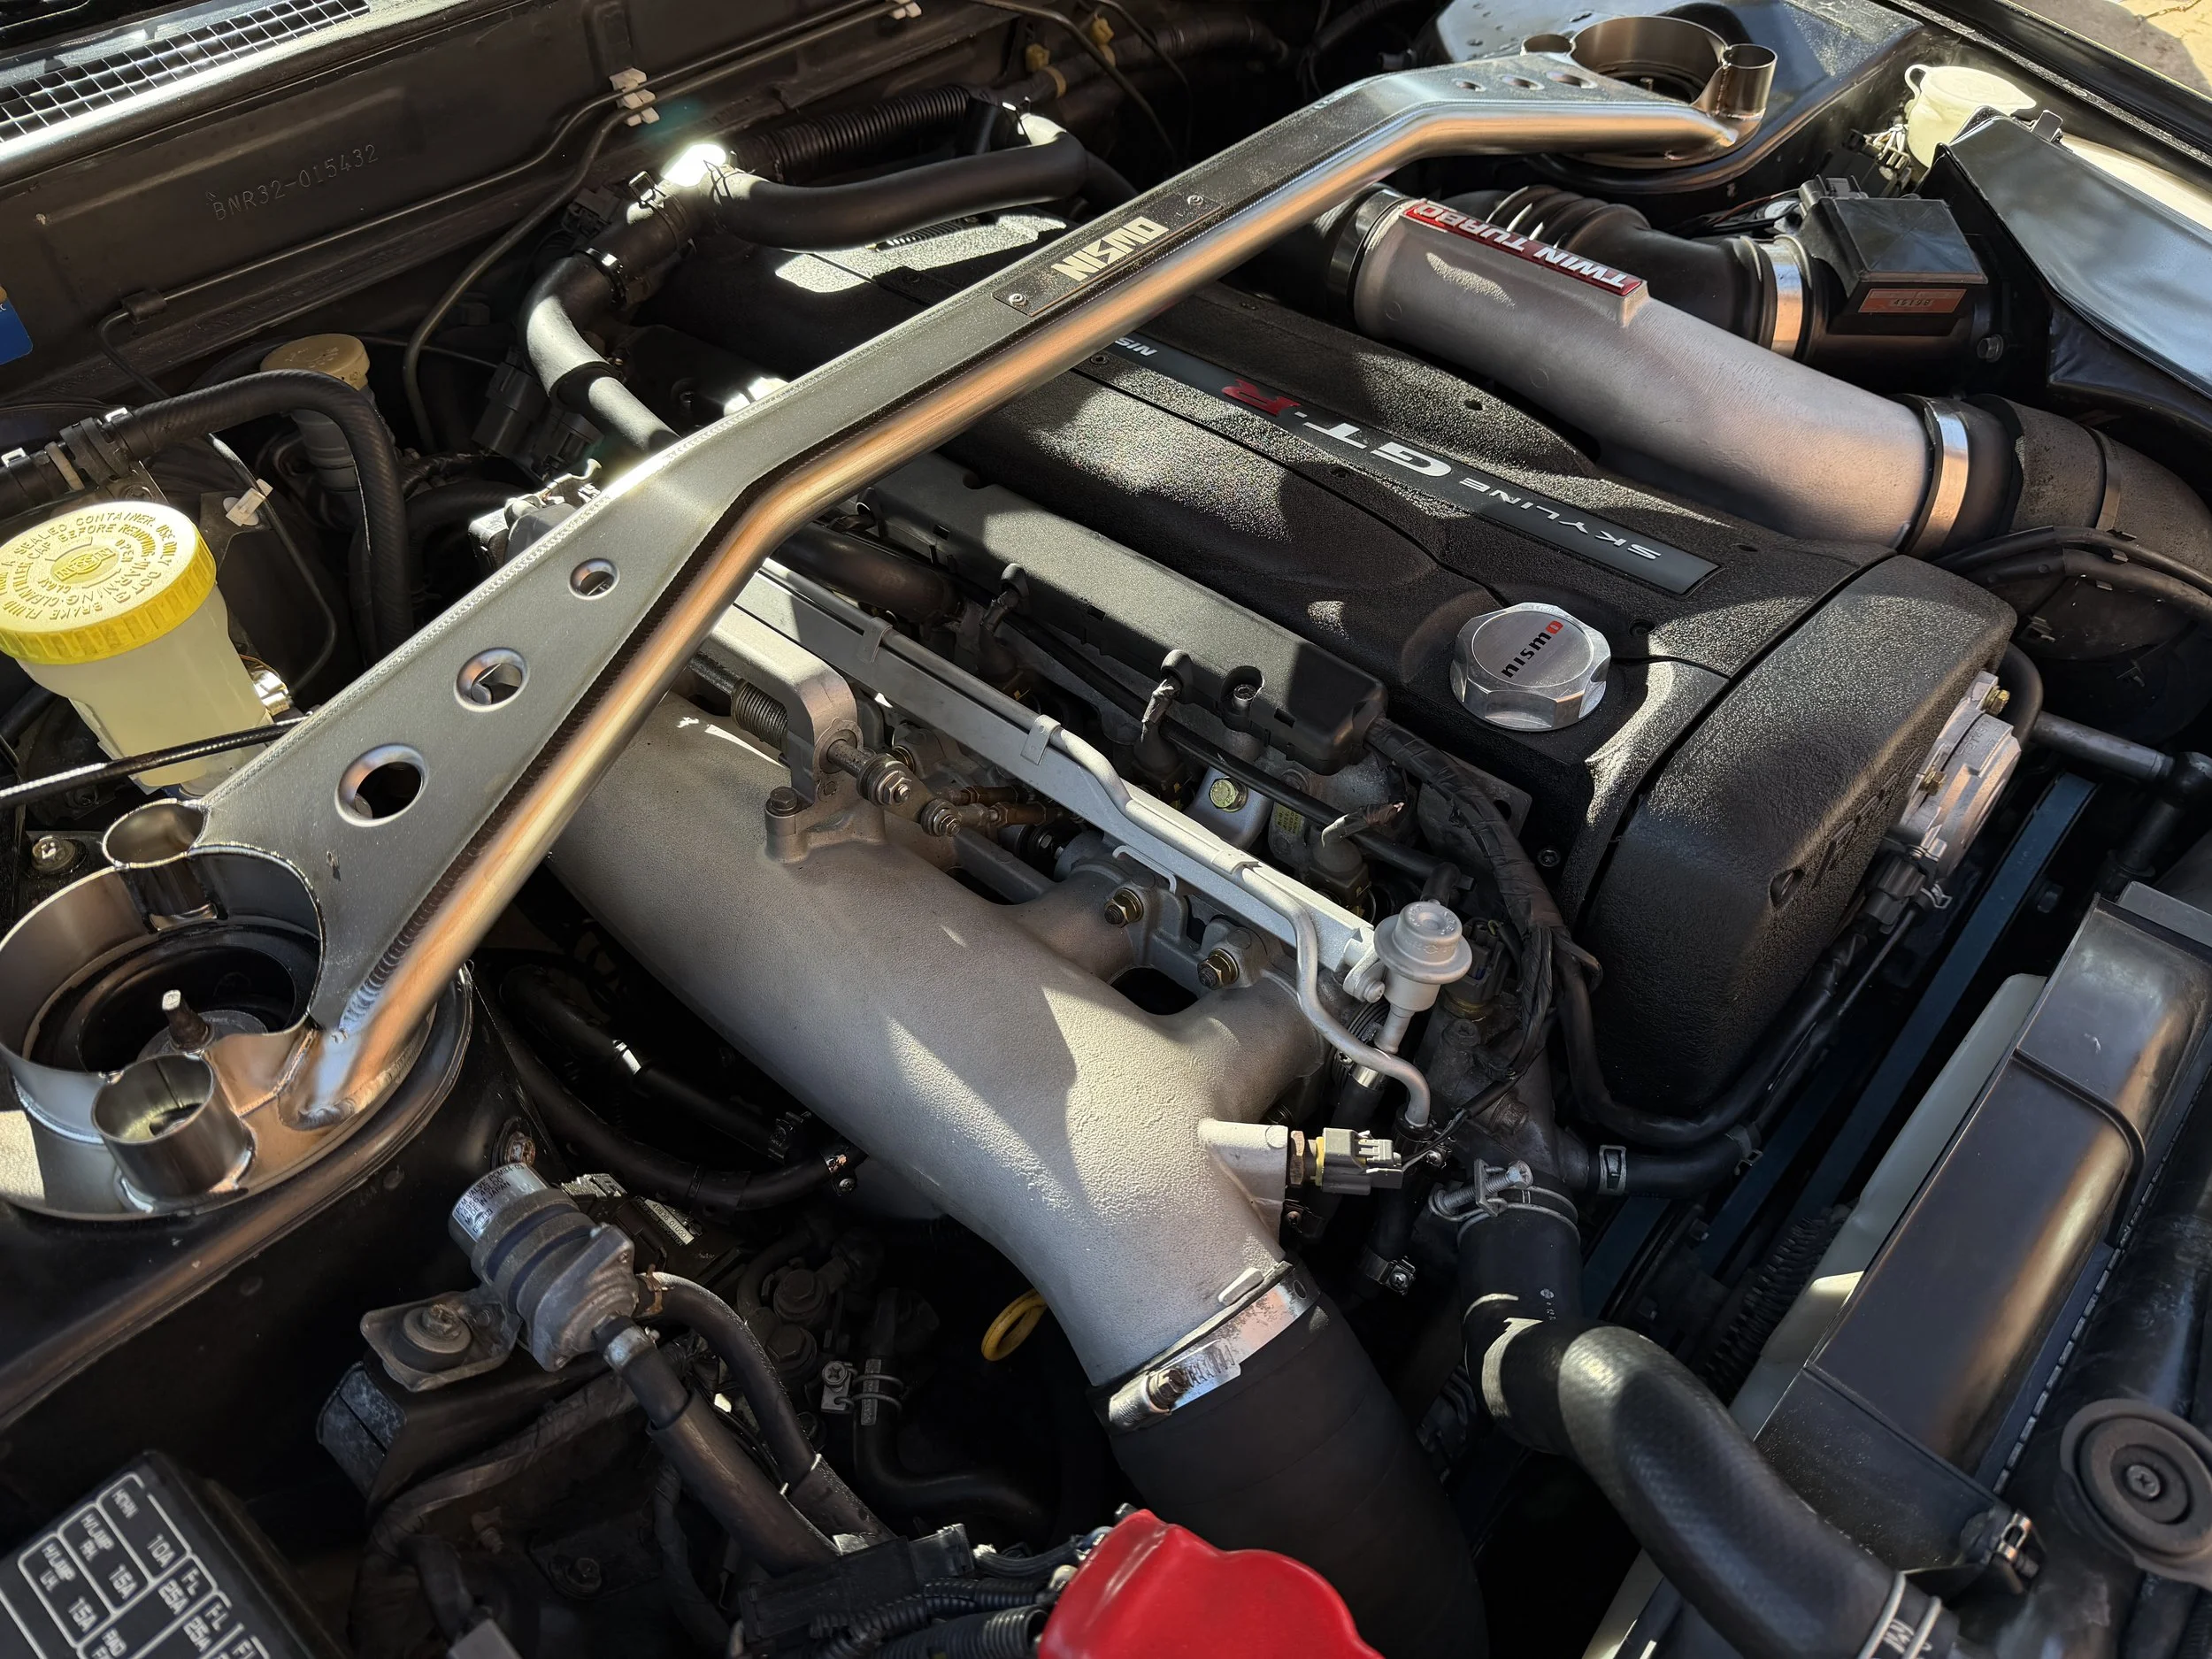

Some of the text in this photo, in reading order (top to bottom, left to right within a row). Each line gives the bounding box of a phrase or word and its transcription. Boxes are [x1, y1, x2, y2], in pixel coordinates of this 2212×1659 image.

[212, 143, 380, 221] BNR32-015432
[1050, 215, 1170, 282] NISMO
[1413, 204, 1628, 290] TWIN TURBO
[1221, 377, 1453, 478] GT-R
[58, 523, 117, 543] BEFORE
[1459, 477, 1663, 561] SKYLINE
[54, 548, 115, 581] NISSAN
[115, 538, 134, 564] OPEN
[130, 571, 162, 595] DOT
[49, 603, 104, 620] BRAKE
[1501, 620, 1564, 679] nismo
[455, 1198, 468, 1215] PCM
[467, 1179, 489, 1199] VALVE
[459, 1194, 480, 1218] 14956
[465, 1204, 480, 1225] MADE
[479, 1197, 488, 1207] IN
[488, 1181, 511, 1201] JAPAN
[81, 1513, 115, 1551] H/LAMP
[42, 1542, 76, 1581] H/LAMP
[147, 1533, 176, 1569] 10A
[108, 1563, 138, 1600] 15A
[157, 1578, 190, 1616] 25A
[180, 1566, 201, 1596] FL
[68, 1596, 97, 1632] 15A
[204, 1601, 228, 1632] FL
[182, 1616, 212, 1653] 25A
